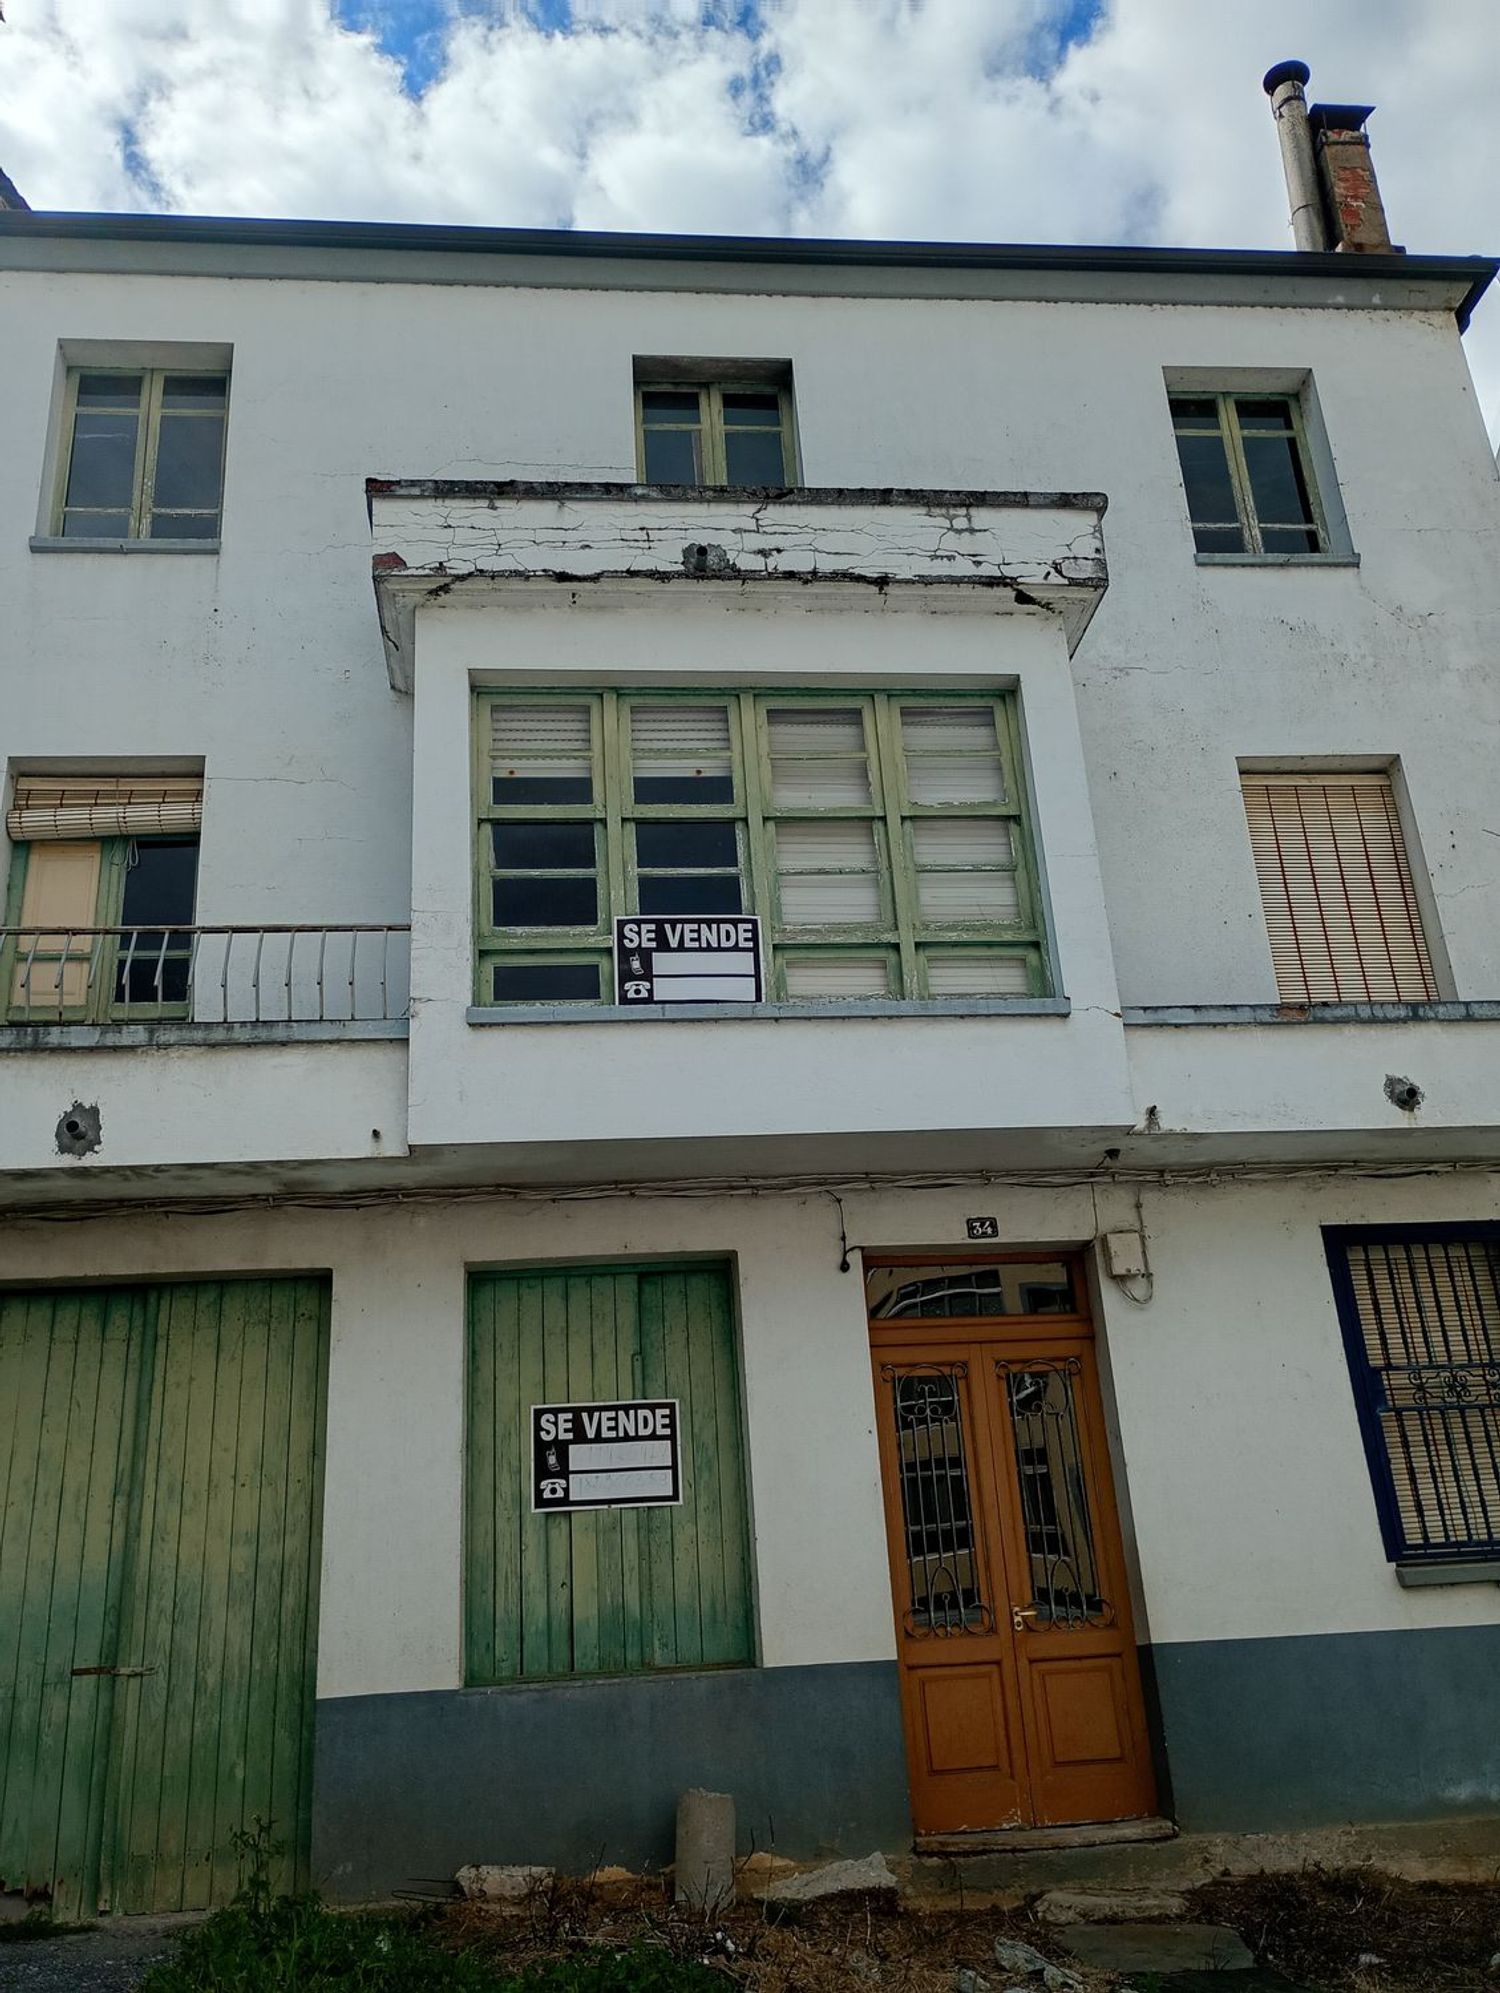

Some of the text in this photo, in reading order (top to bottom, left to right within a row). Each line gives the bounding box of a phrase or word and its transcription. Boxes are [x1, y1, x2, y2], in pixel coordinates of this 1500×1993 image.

[623, 923, 754, 948] SE VENDE
[972, 1221, 993, 1235] 34
[540, 1408, 671, 1441] SE VENDE
